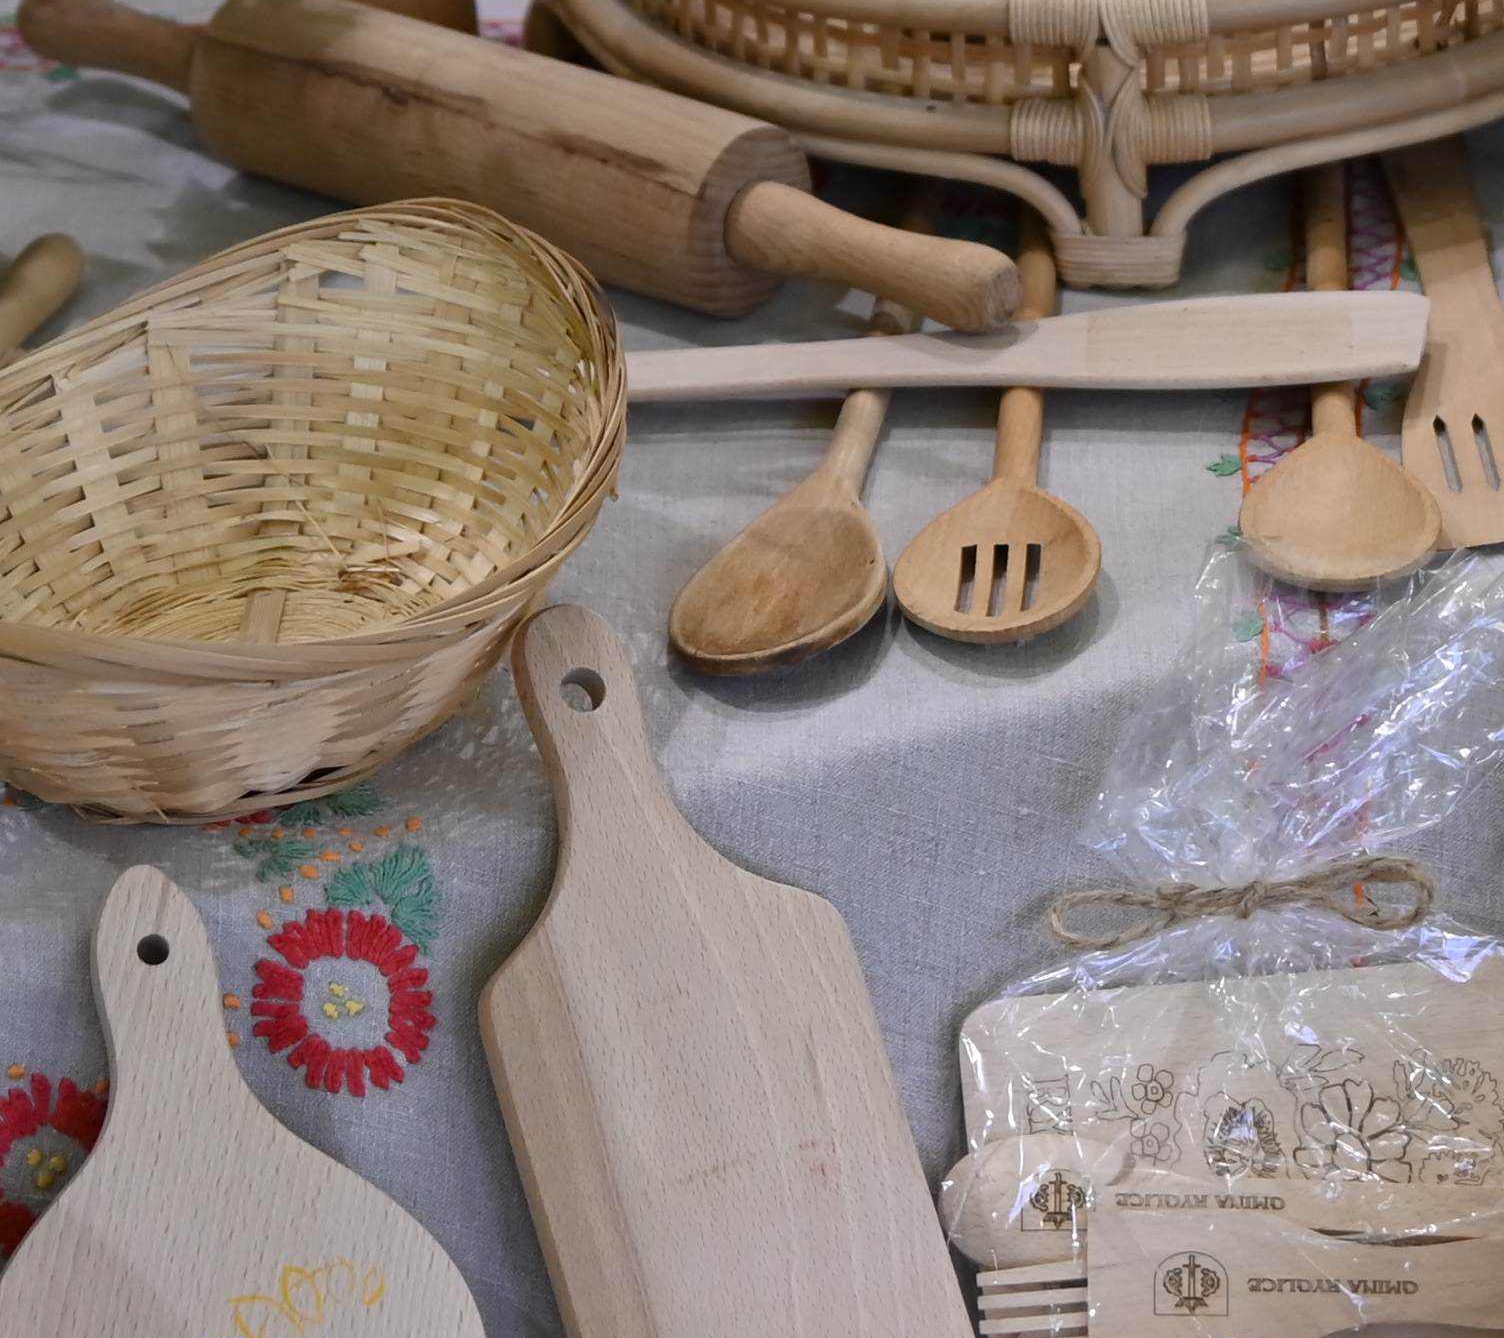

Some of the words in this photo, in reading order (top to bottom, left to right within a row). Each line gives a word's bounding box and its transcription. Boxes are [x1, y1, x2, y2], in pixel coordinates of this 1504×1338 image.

[1114, 1192, 1208, 1210] RYGLICE
[1214, 1194, 1287, 1211] GMINA
[1246, 1277, 1341, 1294] RYGLICE
[1346, 1278, 1420, 1295] GMINA
